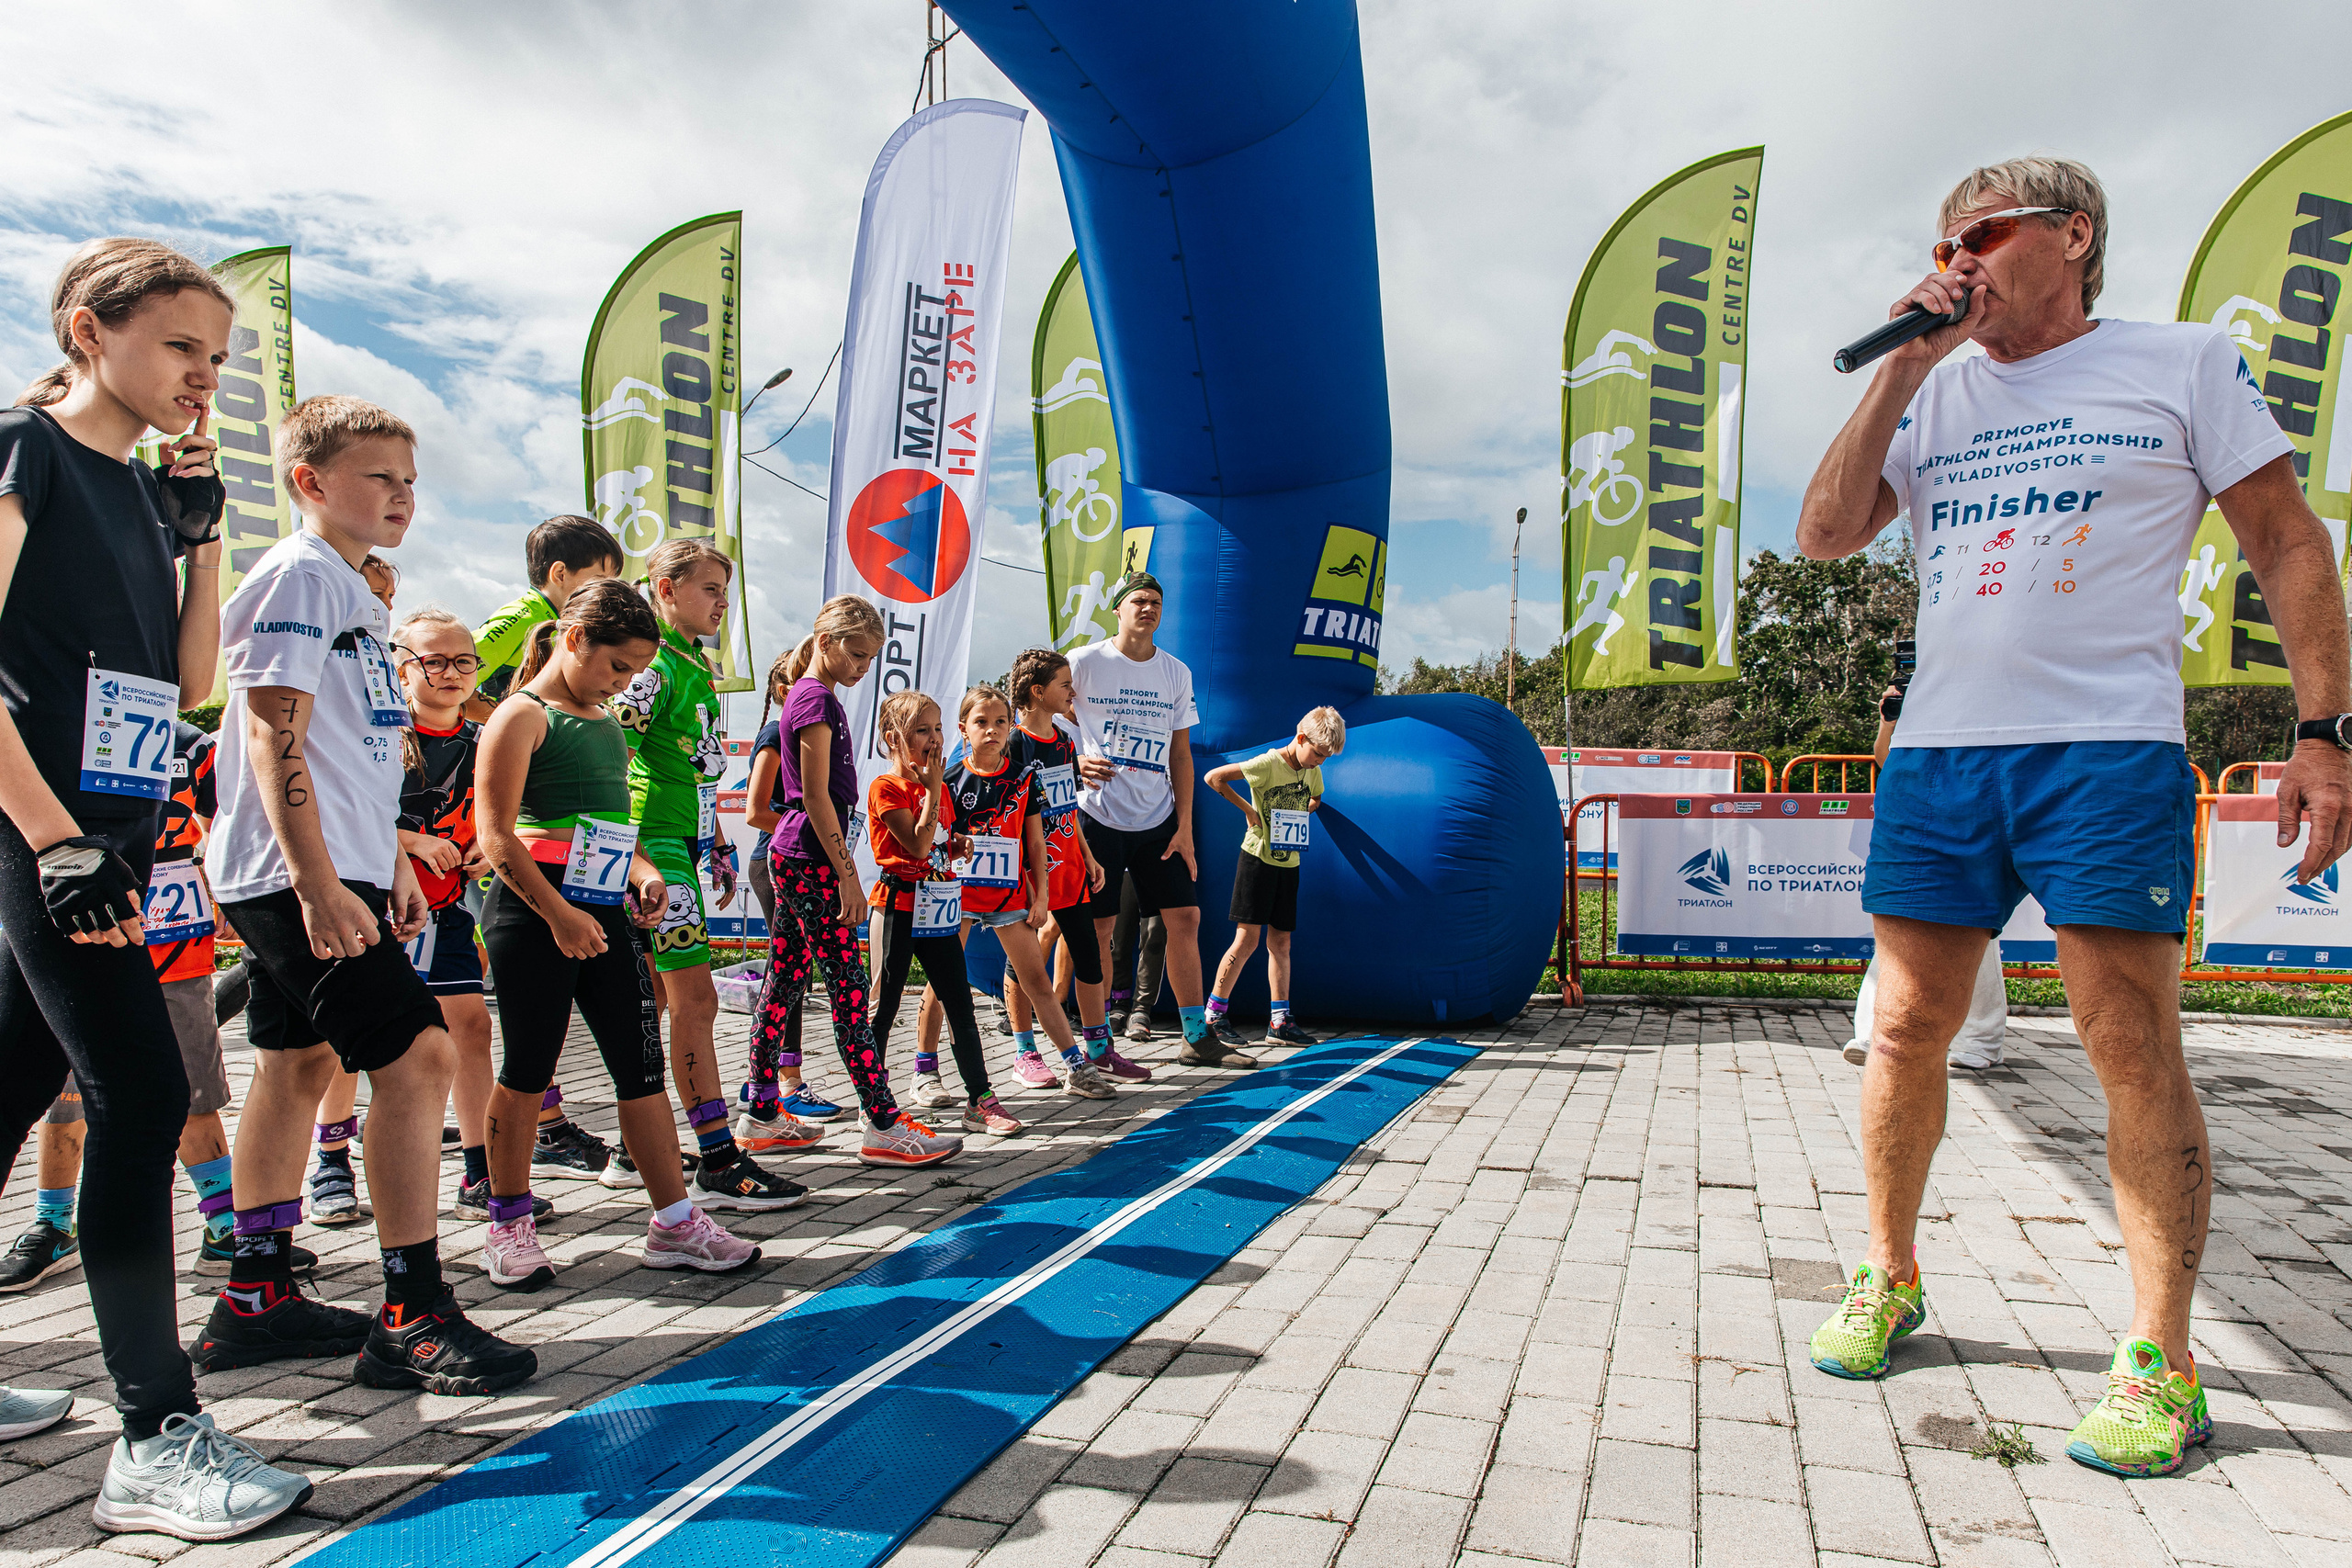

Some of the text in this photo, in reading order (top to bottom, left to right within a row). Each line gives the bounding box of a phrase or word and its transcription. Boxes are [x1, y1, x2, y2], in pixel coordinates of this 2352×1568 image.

[1722, 184, 1753, 346] CENTRE DV
[268, 276, 288, 310] DV
[720, 245, 737, 394] CENTRE DV
[902, 284, 945, 459] МАРКЕТ
[944, 263, 976, 476] НА ЗАРЕ
[1972, 417, 2074, 446] PRIMORYE
[1646, 237, 1712, 671] TRIATHLON
[1996, 433, 2164, 457] CHAMPIONSHIP
[1948, 453, 2085, 484] VLADIVOSTOK
[1931, 486, 2103, 532] Finisher
[1957, 545, 1970, 555] T1
[2031, 535, 2051, 547] T2
[1978, 561, 2007, 577] 20
[2062, 558, 2074, 571] 5
[1975, 581, 2003, 597] 40
[2052, 580, 2076, 594] 10
[1303, 607, 1382, 651] TRIAT
[122, 686, 166, 700] ВСЕРОССИЙСКИЕ
[134, 695, 166, 707] ТРИАТЛОНУ
[1119, 689, 1159, 698] PRIMORYE
[697, 705, 707, 716] 713
[1113, 708, 1161, 718] VLADIVOSTOK
[124, 712, 172, 773] 72
[279, 696, 308, 807] 726
[364, 736, 388, 748] 0,75
[1129, 736, 1166, 761] 717
[373, 752, 388, 762] 1,5
[1046, 778, 1075, 805] 712
[599, 829, 635, 839] ВСЕРОССИЙСКИЕ
[608, 835, 634, 844] ТРИАТЛОНУ
[1283, 822, 1307, 843] 719
[831, 832, 855, 877] 709
[971, 852, 1009, 876] 711
[598, 847, 634, 887] 71
[498, 862, 541, 909] 714
[1748, 879, 1772, 892] ПО
[2148, 886, 2170, 897] arena
[141, 880, 203, 923] 721
[1678, 898, 1733, 908] ТРИАТЛОН
[2276, 906, 2338, 916] ТРИАТЛОН
[652, 920, 708, 953] DOG
[1217, 954, 1237, 988] 719
[60, 1092, 82, 1101] FAS
[235, 1235, 277, 1243] SPORT
[235, 1242, 277, 1258] 24
